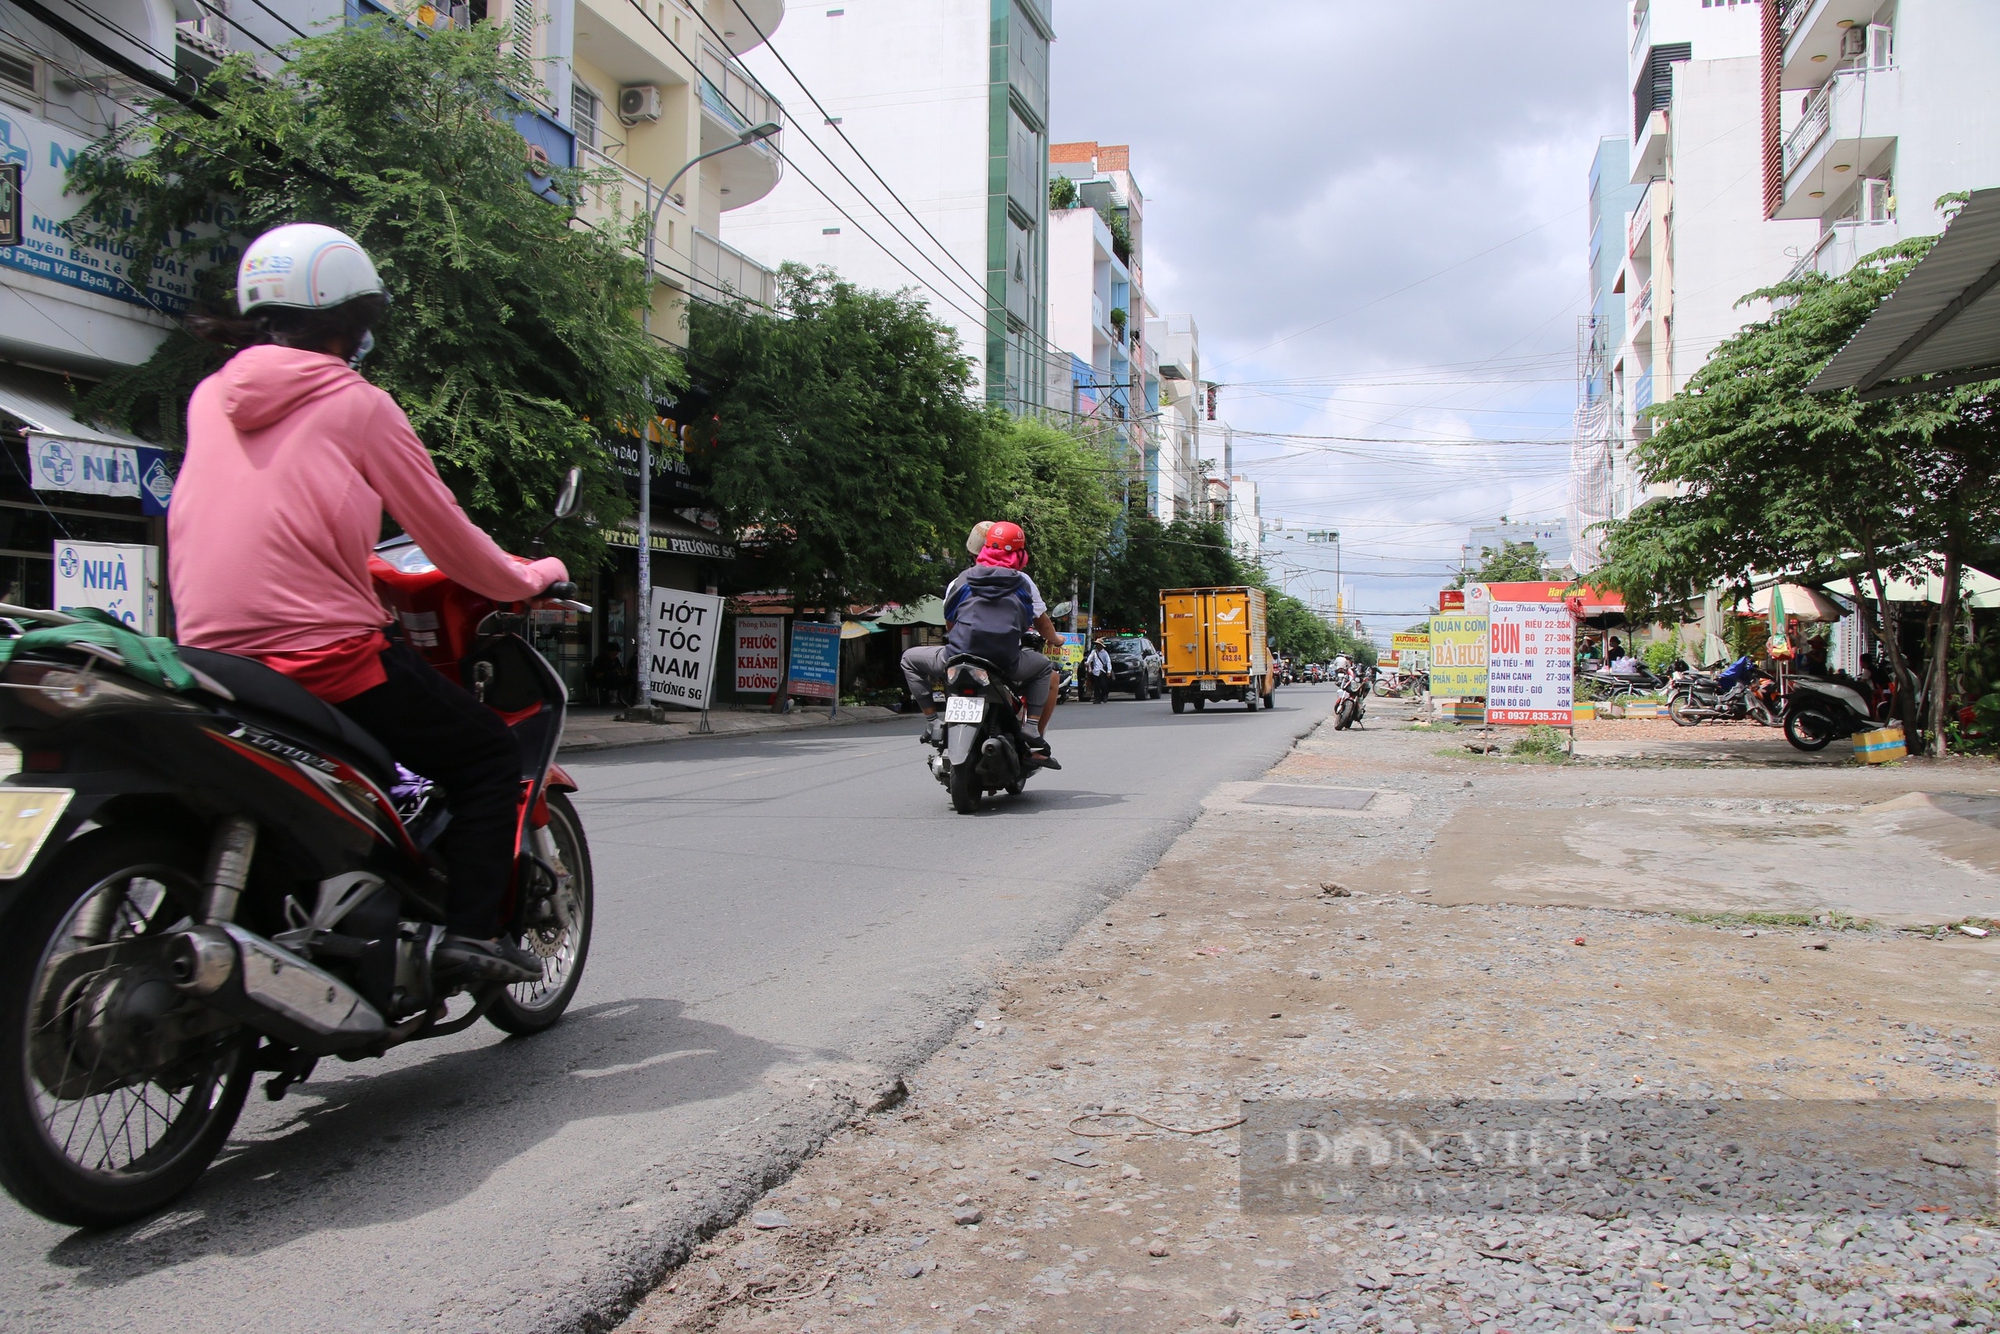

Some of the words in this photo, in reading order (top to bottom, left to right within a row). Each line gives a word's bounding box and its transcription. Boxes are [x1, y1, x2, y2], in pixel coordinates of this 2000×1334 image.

[15, 251, 51, 272] Phạm
[54, 262, 77, 280] Văn
[80, 270, 113, 293] Bạch,
[116, 281, 128, 296] P.
[69, 248, 99, 268] Bán
[158, 276, 188, 296] Loại
[670, 538, 720, 556] PHƯƠNG
[722, 545, 736, 558] SG
[83, 553, 128, 591] NHÀ
[660, 600, 707, 626] HỚT
[1492, 603, 1513, 613] Quán
[738, 620, 758, 630] Phòng
[760, 620, 778, 629] Khám
[1434, 618, 1461, 634] QUÁN
[1464, 619, 1487, 632] CƠM
[1524, 618, 1542, 629] RIÊU
[1544, 620, 1571, 629] 22-25K
[658, 626, 701, 653] TÓC
[739, 633, 777, 649] PHƯỚC
[1491, 616, 1520, 654] BÚN
[1544, 633, 1571, 642] 27-30K
[1434, 638, 1455, 667] BÀ
[1456, 634, 1486, 667] HUẾ
[1544, 646, 1571, 655] 27-30K
[651, 654, 700, 680] NAM
[738, 653, 778, 669] KHÁNH
[1546, 659, 1571, 668] 27-30K
[738, 672, 778, 689] ĐƯỜNG
[1491, 671, 1511, 681] BÁNH
[1512, 672, 1532, 681] CANH
[1545, 672, 1571, 681] 27-30K
[687, 687, 702, 700] SG
[1490, 684, 1506, 694] BÚN
[1556, 686, 1571, 694] 35K
[952, 700, 978, 709] 59-G1
[1490, 697, 1506, 707] BÚN
[1556, 699, 1571, 708] 40K
[948, 710, 980, 721] 759.37
[1491, 711, 1506, 721] ĐT:
[1507, 711, 1568, 722] 0937.835.374
